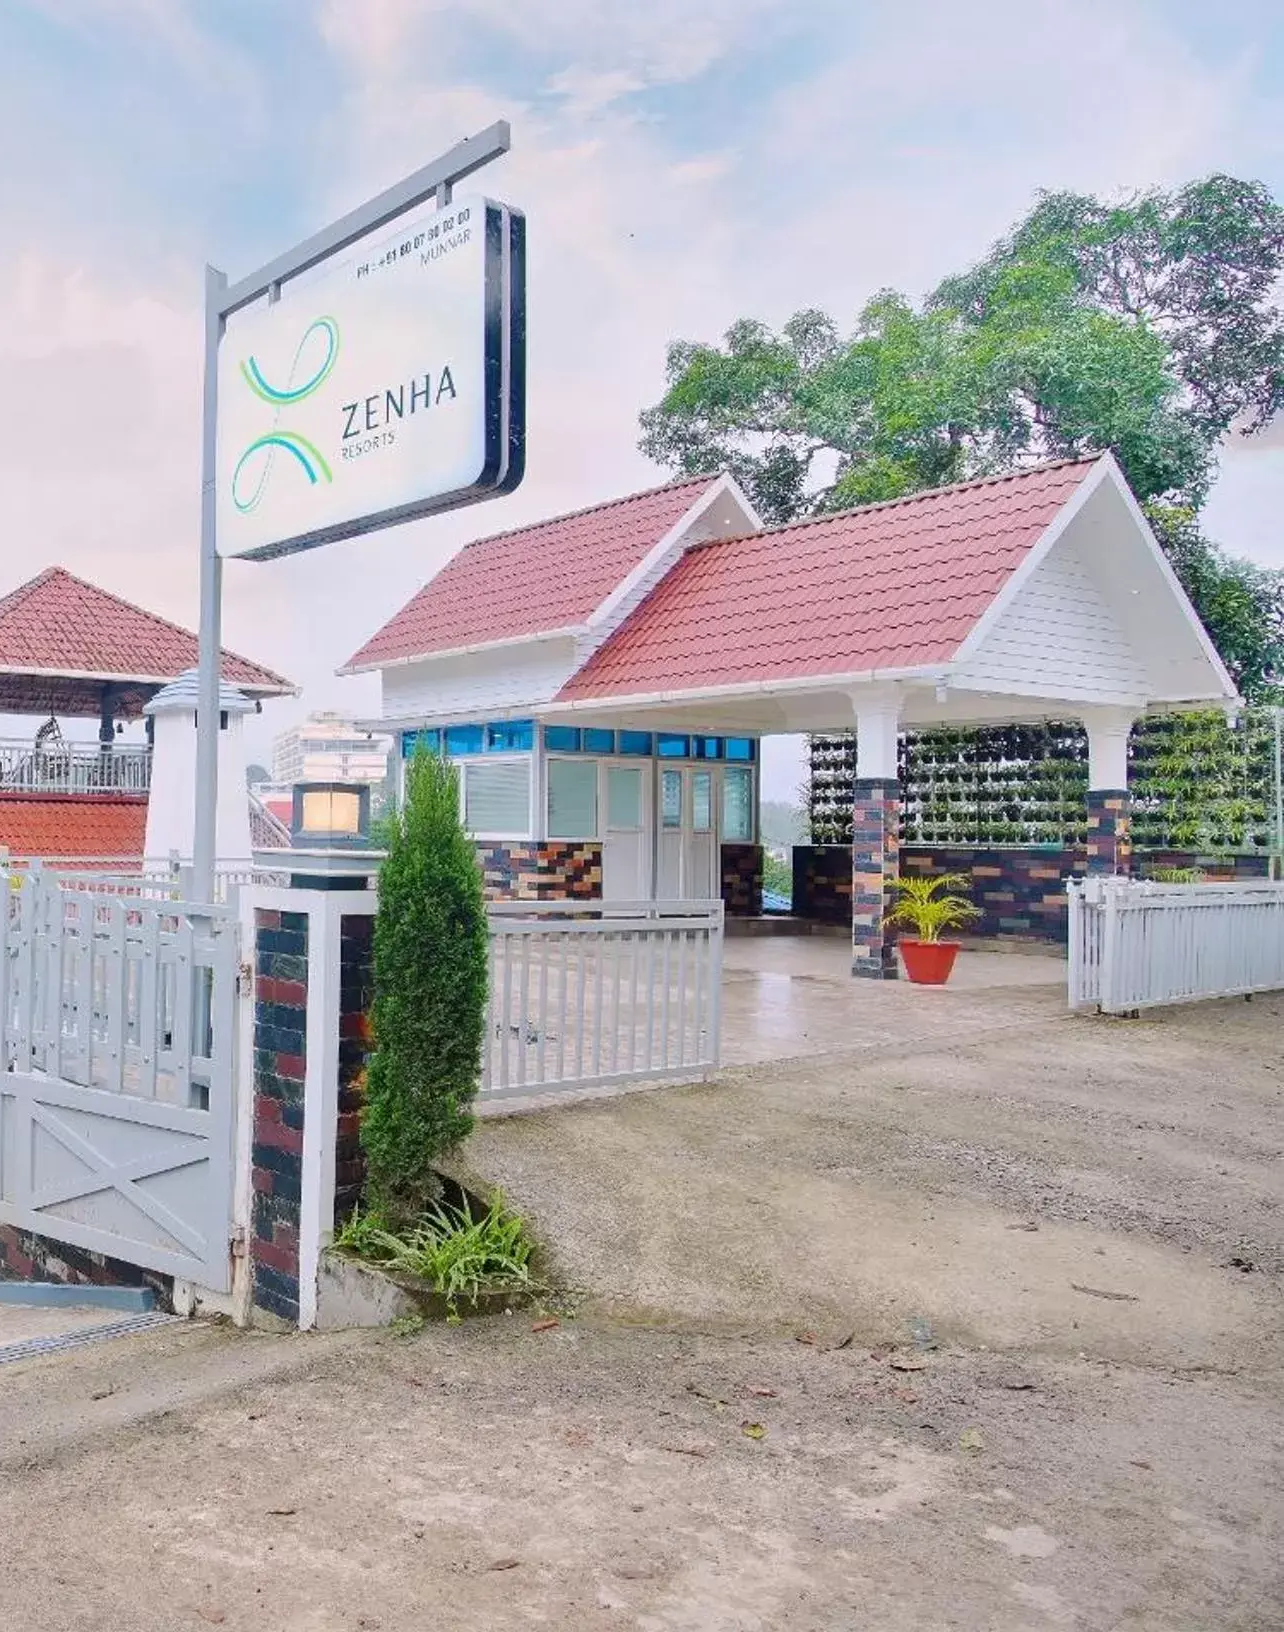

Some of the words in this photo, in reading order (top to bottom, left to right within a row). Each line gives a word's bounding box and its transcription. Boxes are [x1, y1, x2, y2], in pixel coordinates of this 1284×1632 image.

[420, 229, 471, 266] MUNNAR
[357, 264, 369, 279] PH
[342, 366, 457, 439] ZENHA
[341, 432, 395, 460] RESORTS
